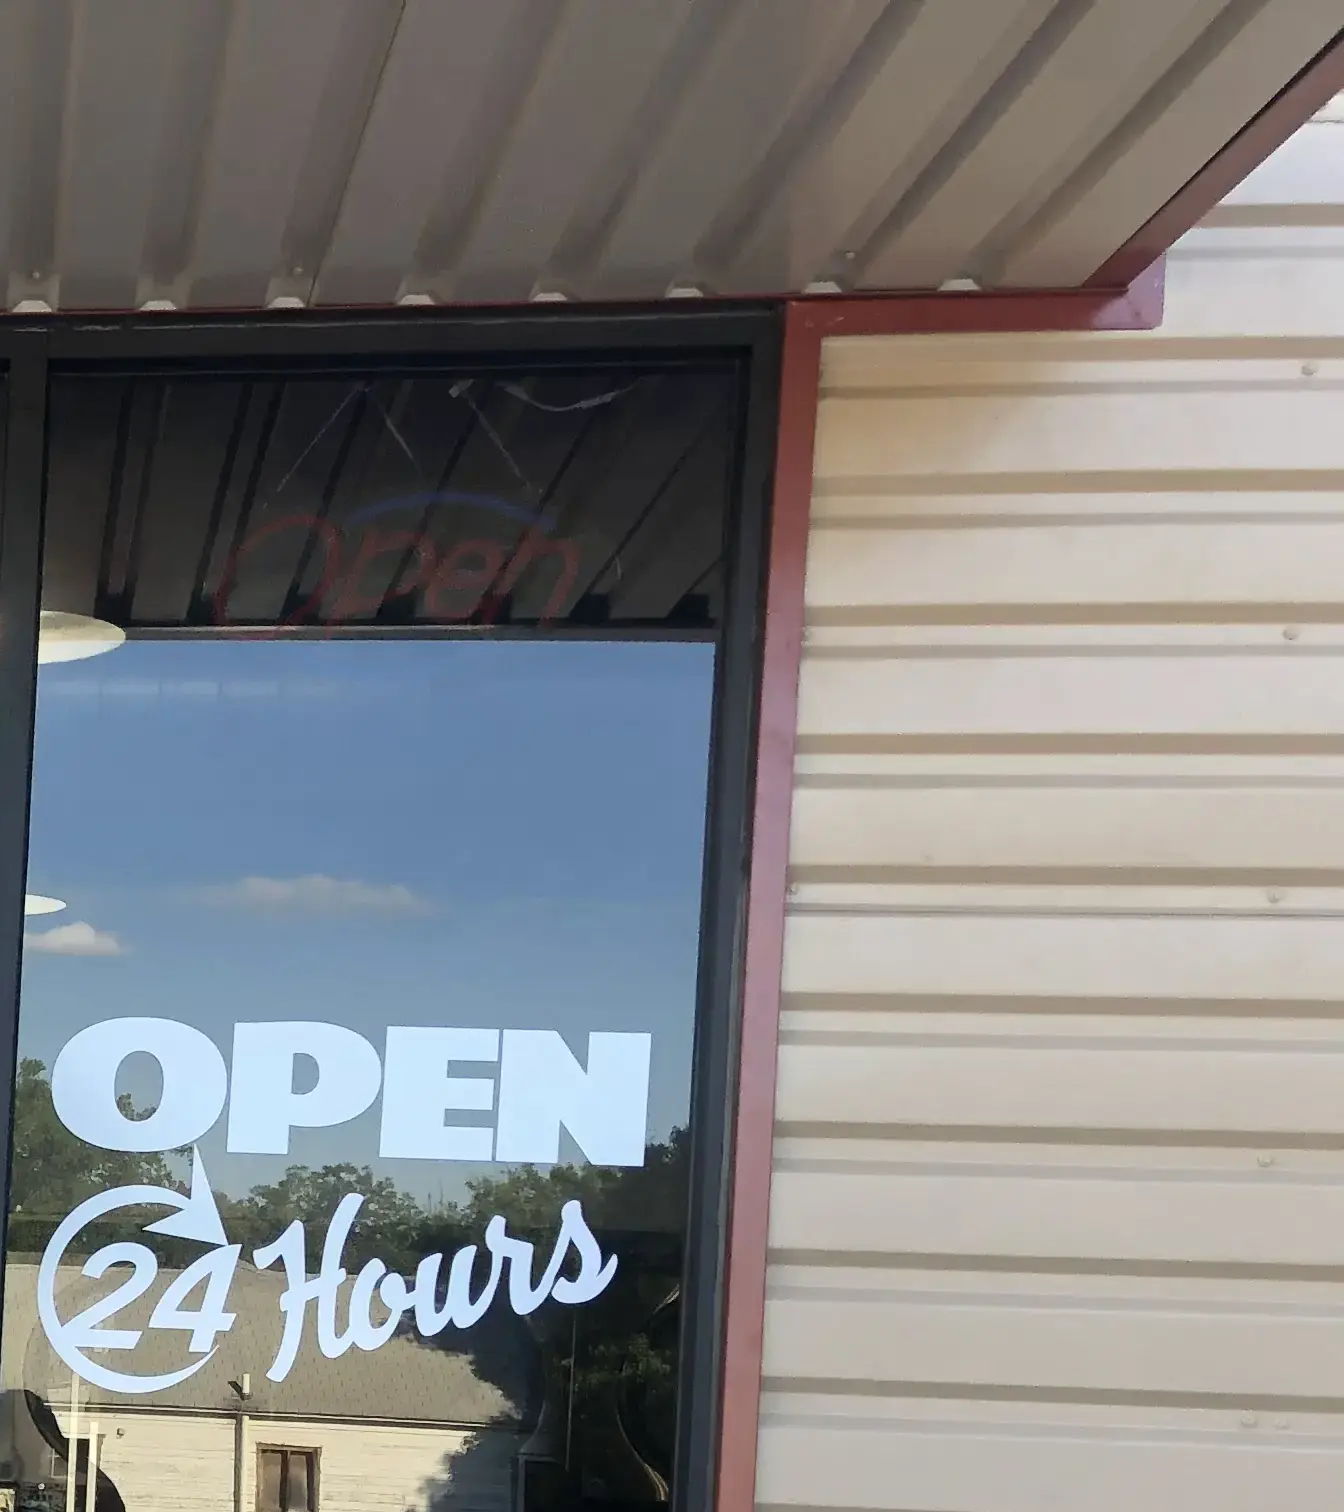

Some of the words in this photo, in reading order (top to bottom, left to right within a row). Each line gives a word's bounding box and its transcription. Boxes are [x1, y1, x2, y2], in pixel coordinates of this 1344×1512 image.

[52, 1016, 652, 1167] OPEN
[60, 1241, 243, 1354] 24
[253, 1192, 618, 1383] Hours
